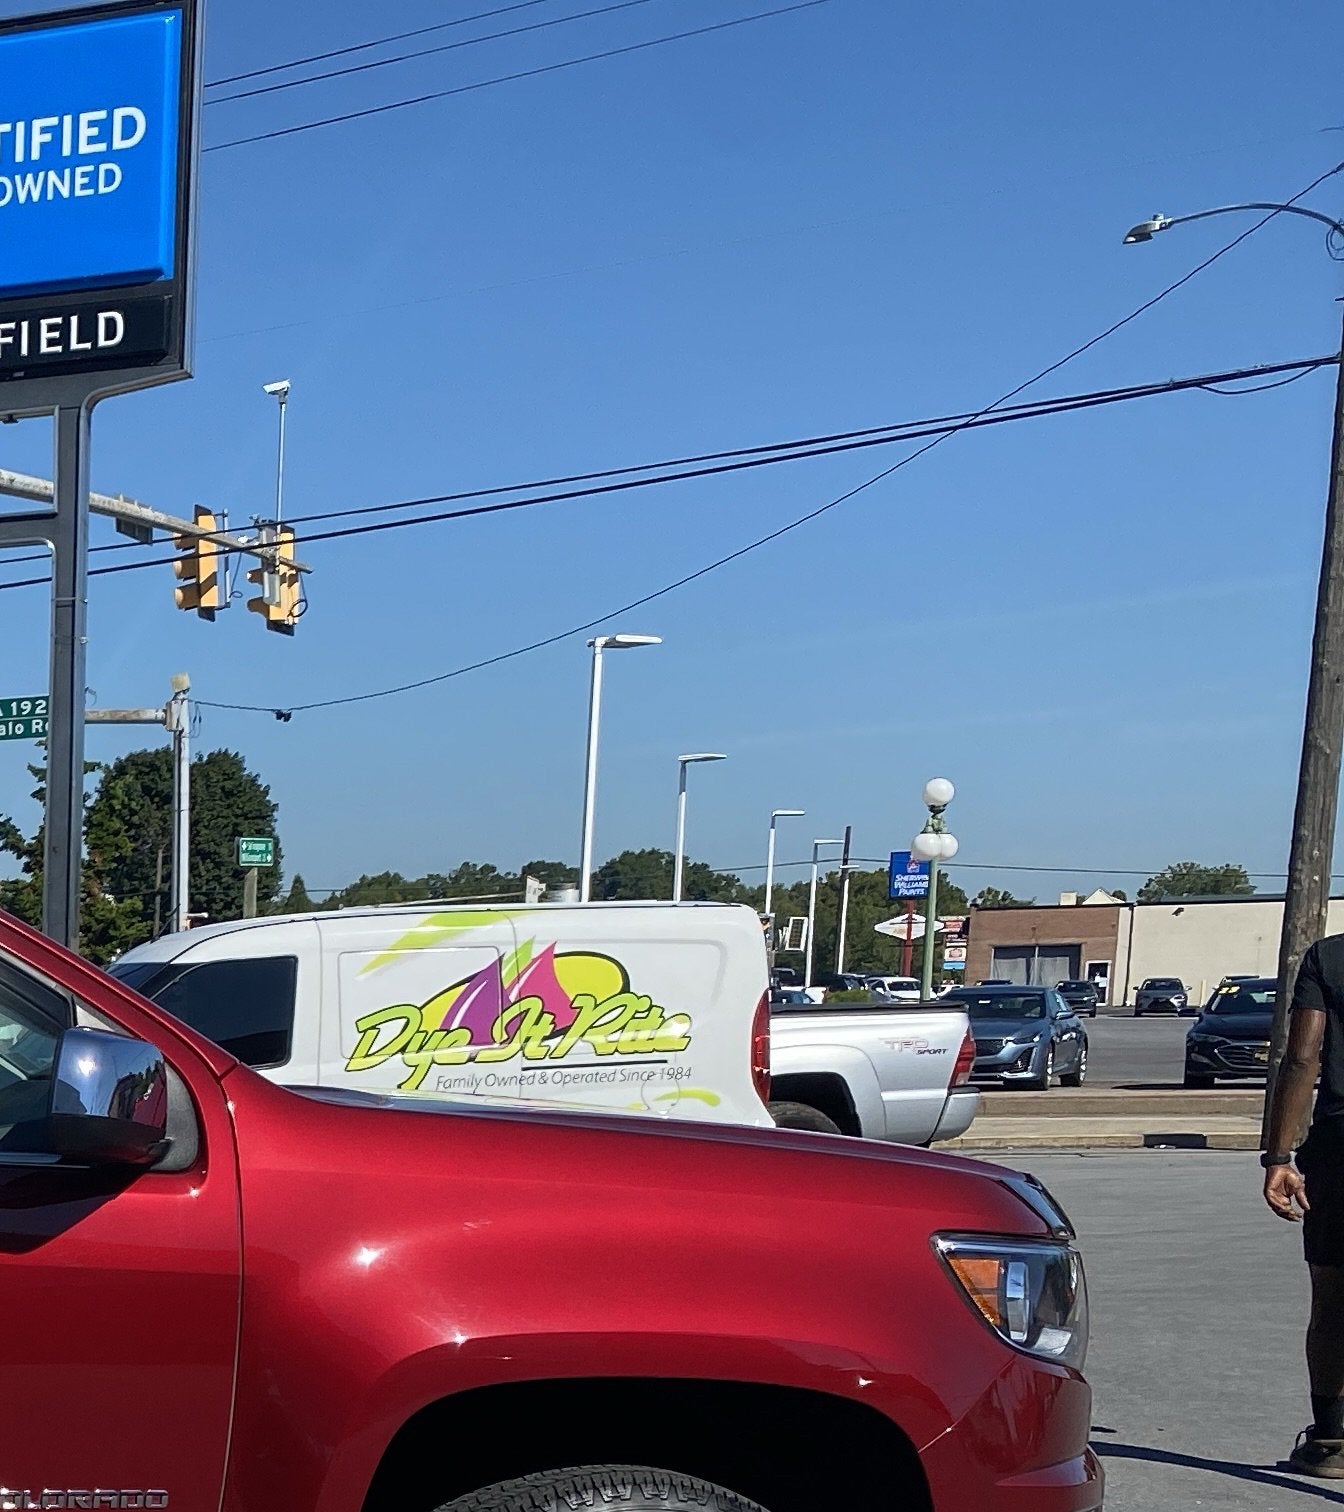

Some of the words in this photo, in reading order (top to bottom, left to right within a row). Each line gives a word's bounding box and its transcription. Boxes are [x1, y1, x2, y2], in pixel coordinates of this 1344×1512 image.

[11, 699, 47, 716] 192
[32, 719, 49, 734] R
[345, 1004, 474, 1090] Dye
[474, 995, 559, 1062] It
[549, 991, 692, 1060] Rite
[435, 1073, 482, 1095] Family
[484, 1070, 536, 1087] Owned
[538, 1071, 549, 1084] &
[550, 1068, 616, 1087] Operated
[618, 1067, 655, 1083] Since
[661, 1066, 693, 1081] 1984
